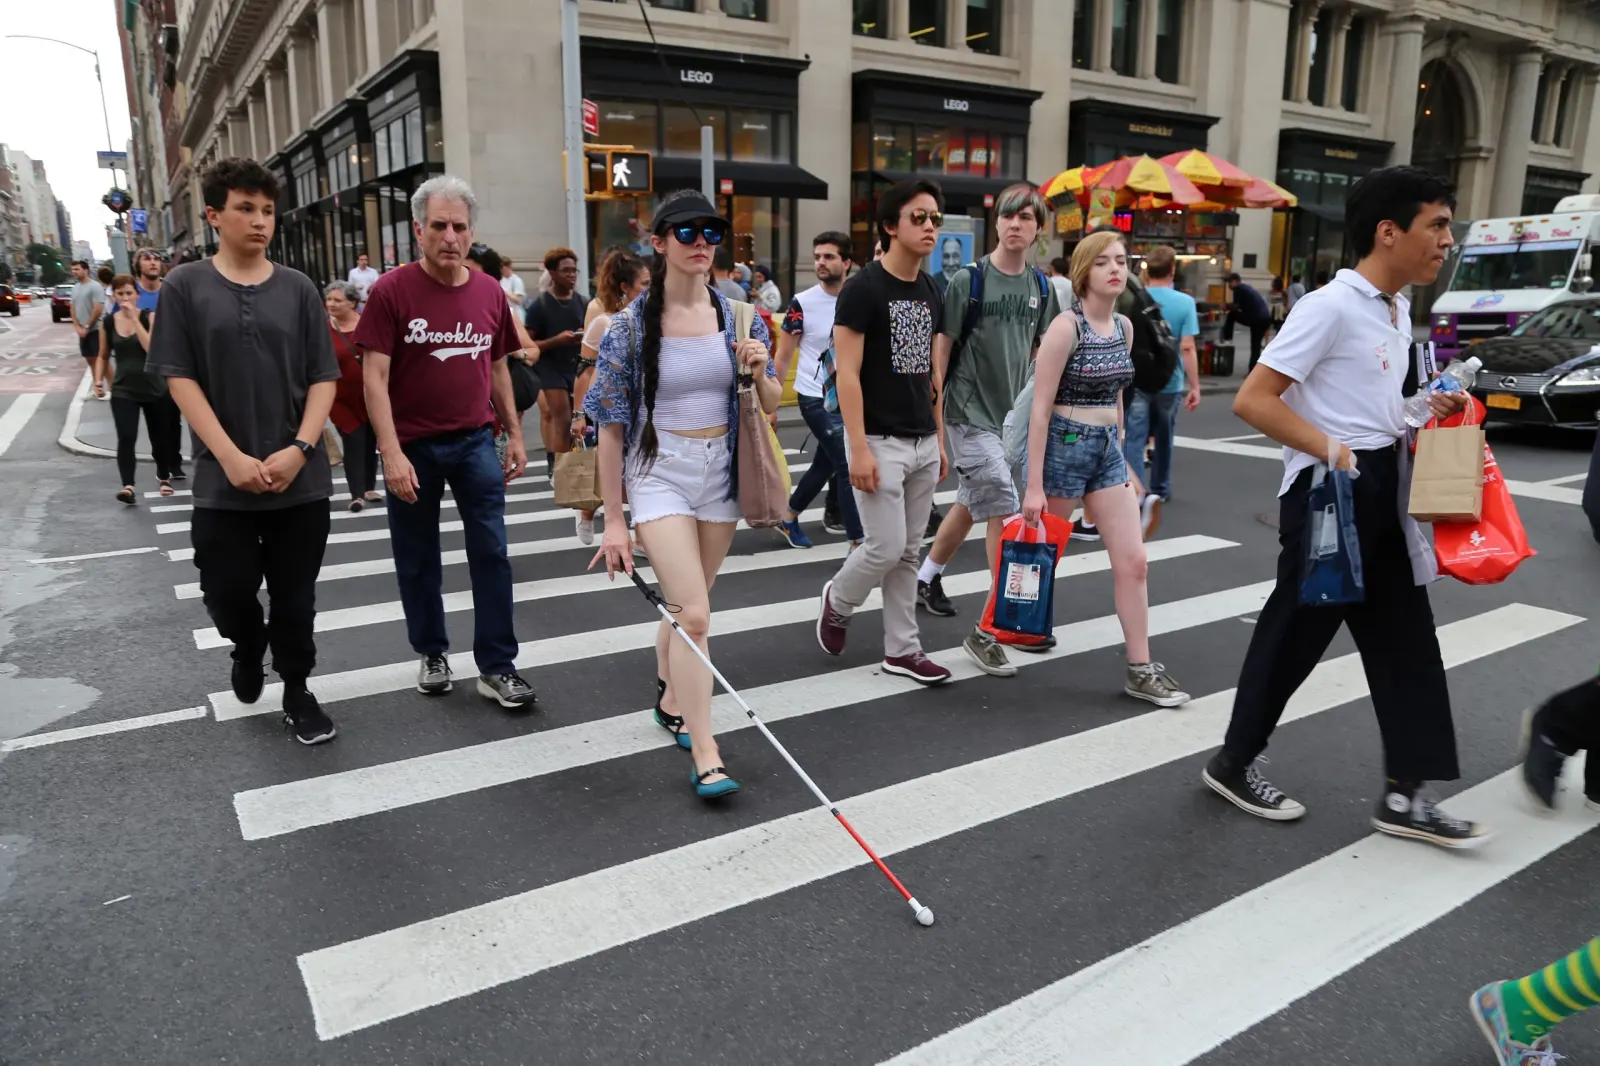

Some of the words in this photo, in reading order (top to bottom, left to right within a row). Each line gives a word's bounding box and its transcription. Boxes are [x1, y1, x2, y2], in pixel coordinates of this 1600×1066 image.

[680, 69, 714, 84] LEGO
[943, 98, 969, 111] LEGO
[404, 318, 492, 360] Brooklyn
